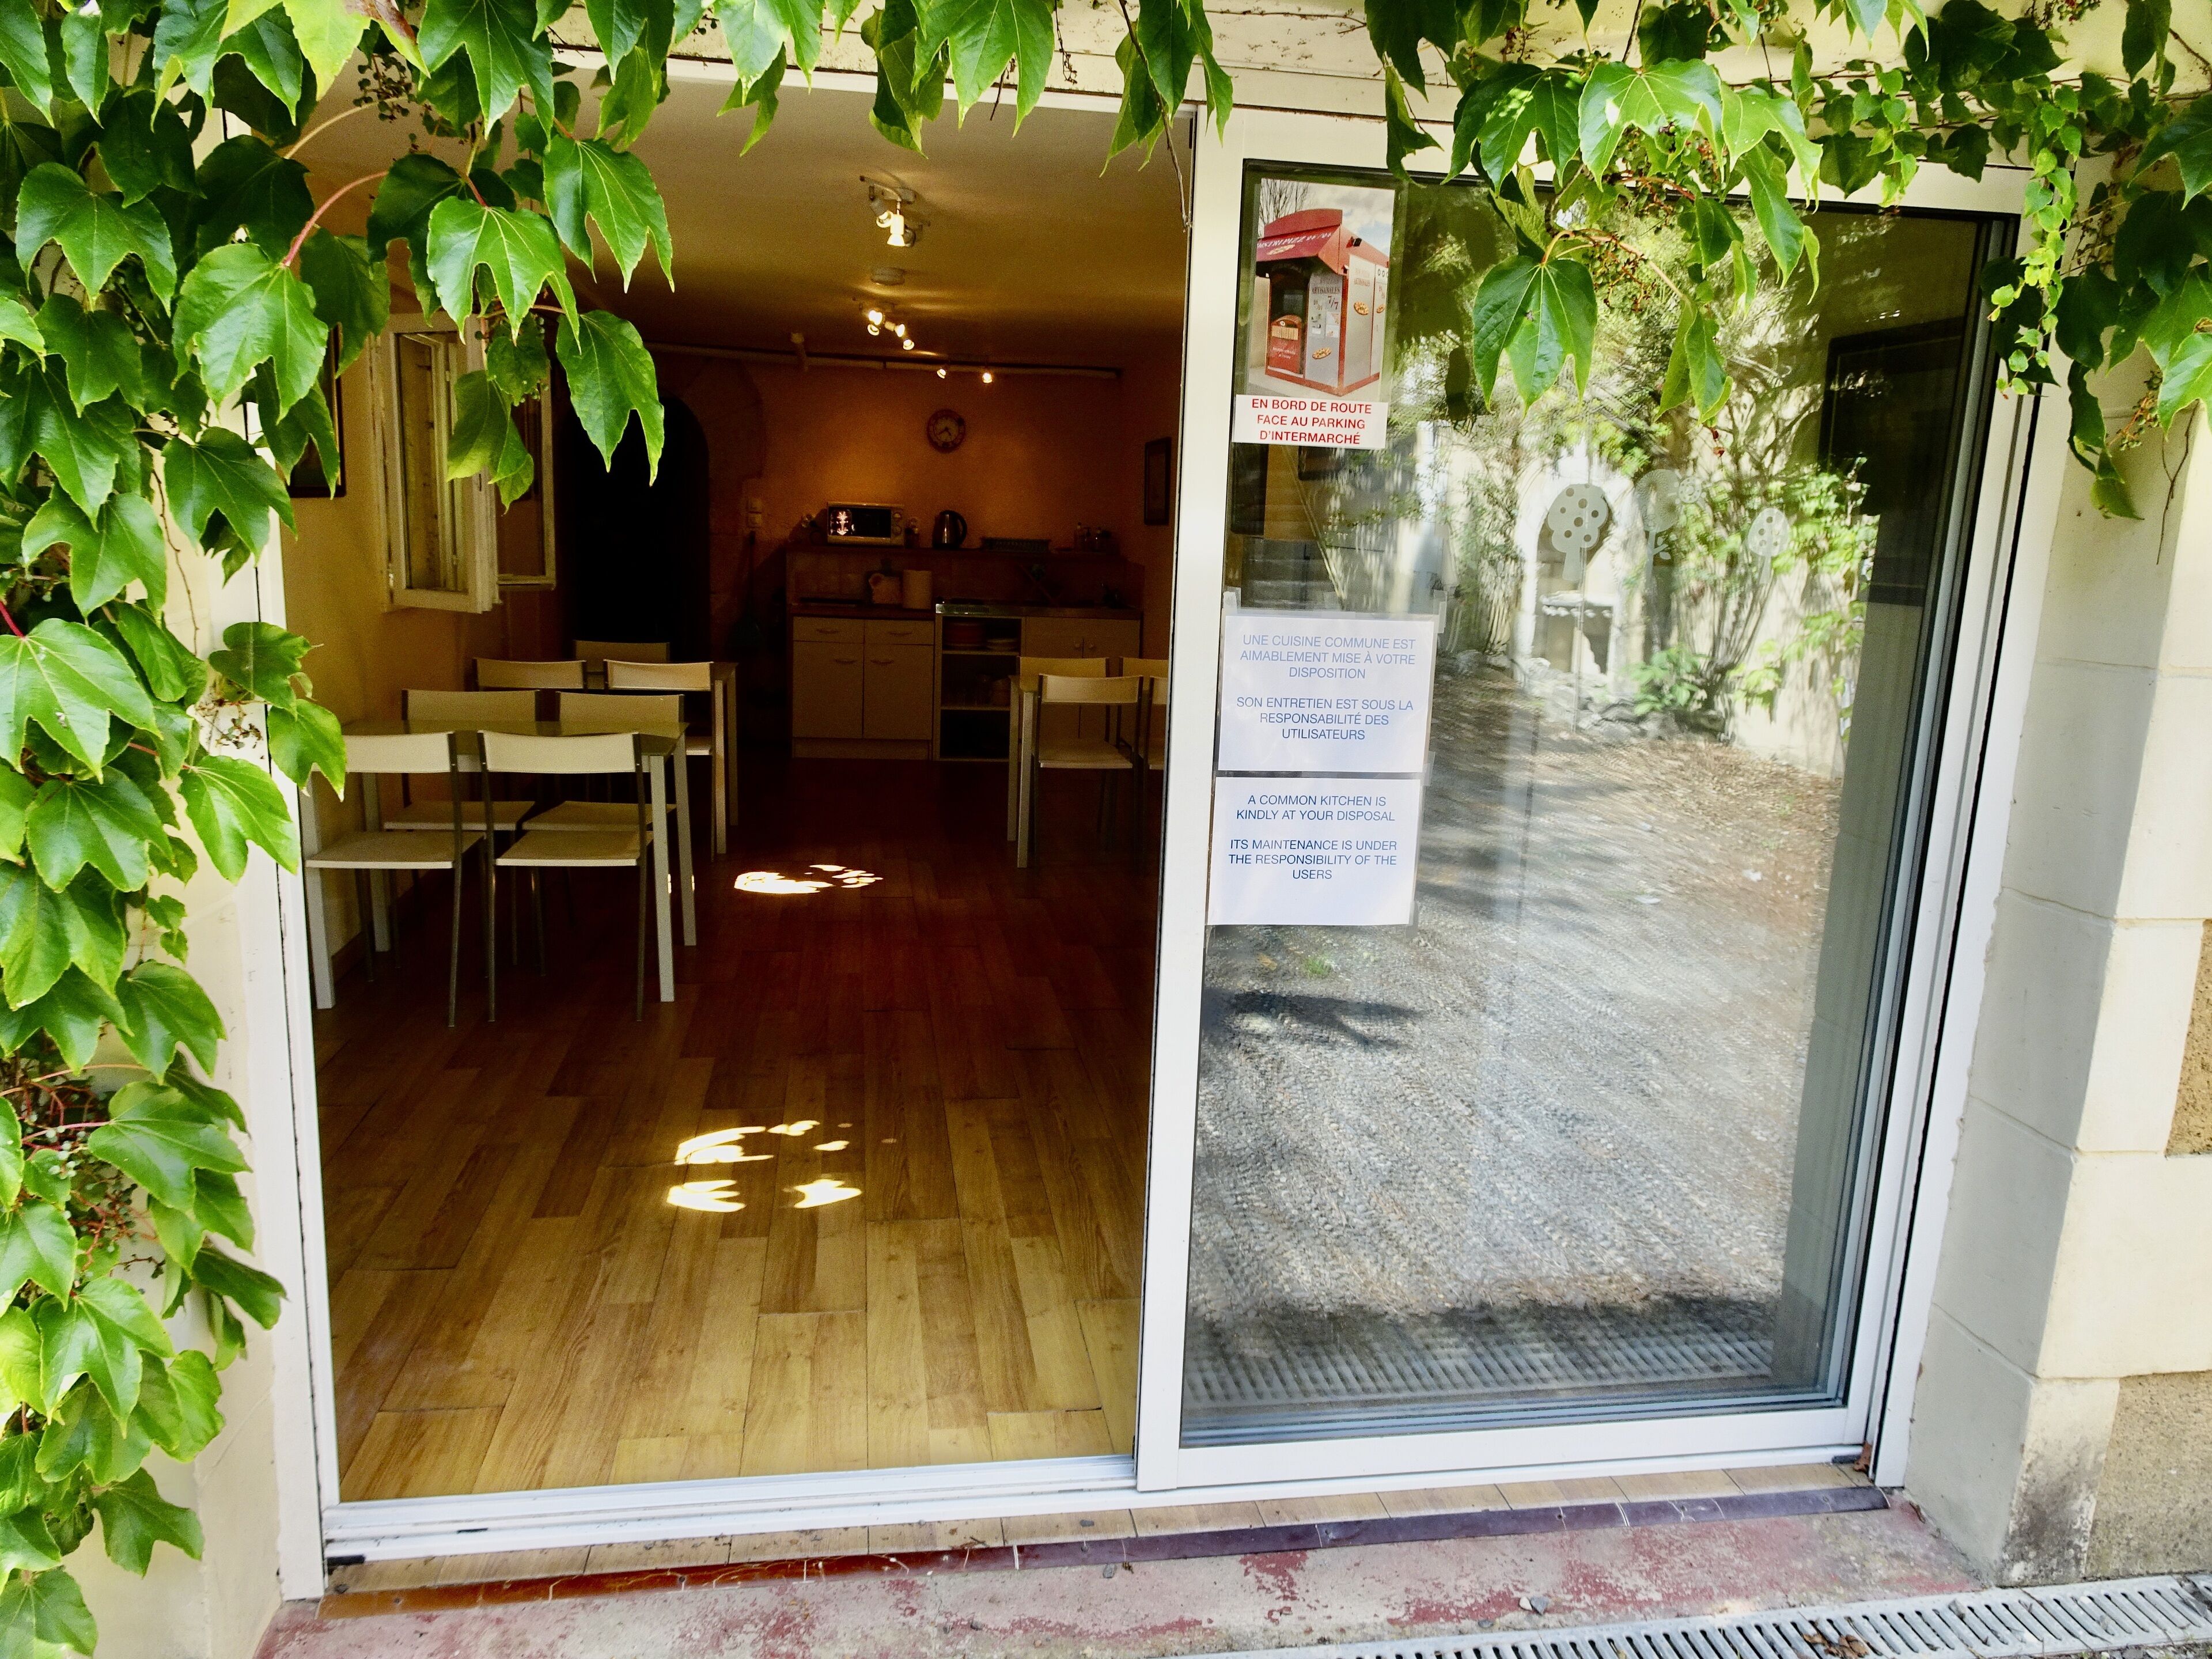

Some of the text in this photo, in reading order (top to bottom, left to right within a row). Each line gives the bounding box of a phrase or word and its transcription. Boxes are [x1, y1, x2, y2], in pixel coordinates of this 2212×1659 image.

[1327, 296, 1339, 310] 7/7
[1251, 398, 1372, 415] EN BORD DE ROUTE
[1257, 414, 1365, 430] FACE AU PARKING
[1259, 429, 1361, 445] D'INTERMARCHÉ
[1243, 634, 1416, 649] UNE CUISINE COMMUNE EST
[1240, 650, 1416, 665] AIMABLEMENT MISE À VOTRE
[1289, 666, 1366, 679] DISPOSITION
[1236, 696, 1414, 711] SON ENTRETIEN EST SOUS LA
[1260, 711, 1389, 725] RESPONSABILITÉ DES
[1282, 728, 1365, 740] UTILISATEURS
[1247, 794, 1387, 806] A COMMON KITCHEN IS
[1236, 809, 1396, 821] KINDLY AT YOUR DISPOSAL
[1230, 839, 1397, 851] ITS MAINTENANCE IS UNDER
[1228, 854, 1397, 865] THE RESPONSIBILITY OF THE
[1292, 869, 1332, 880] USERS
